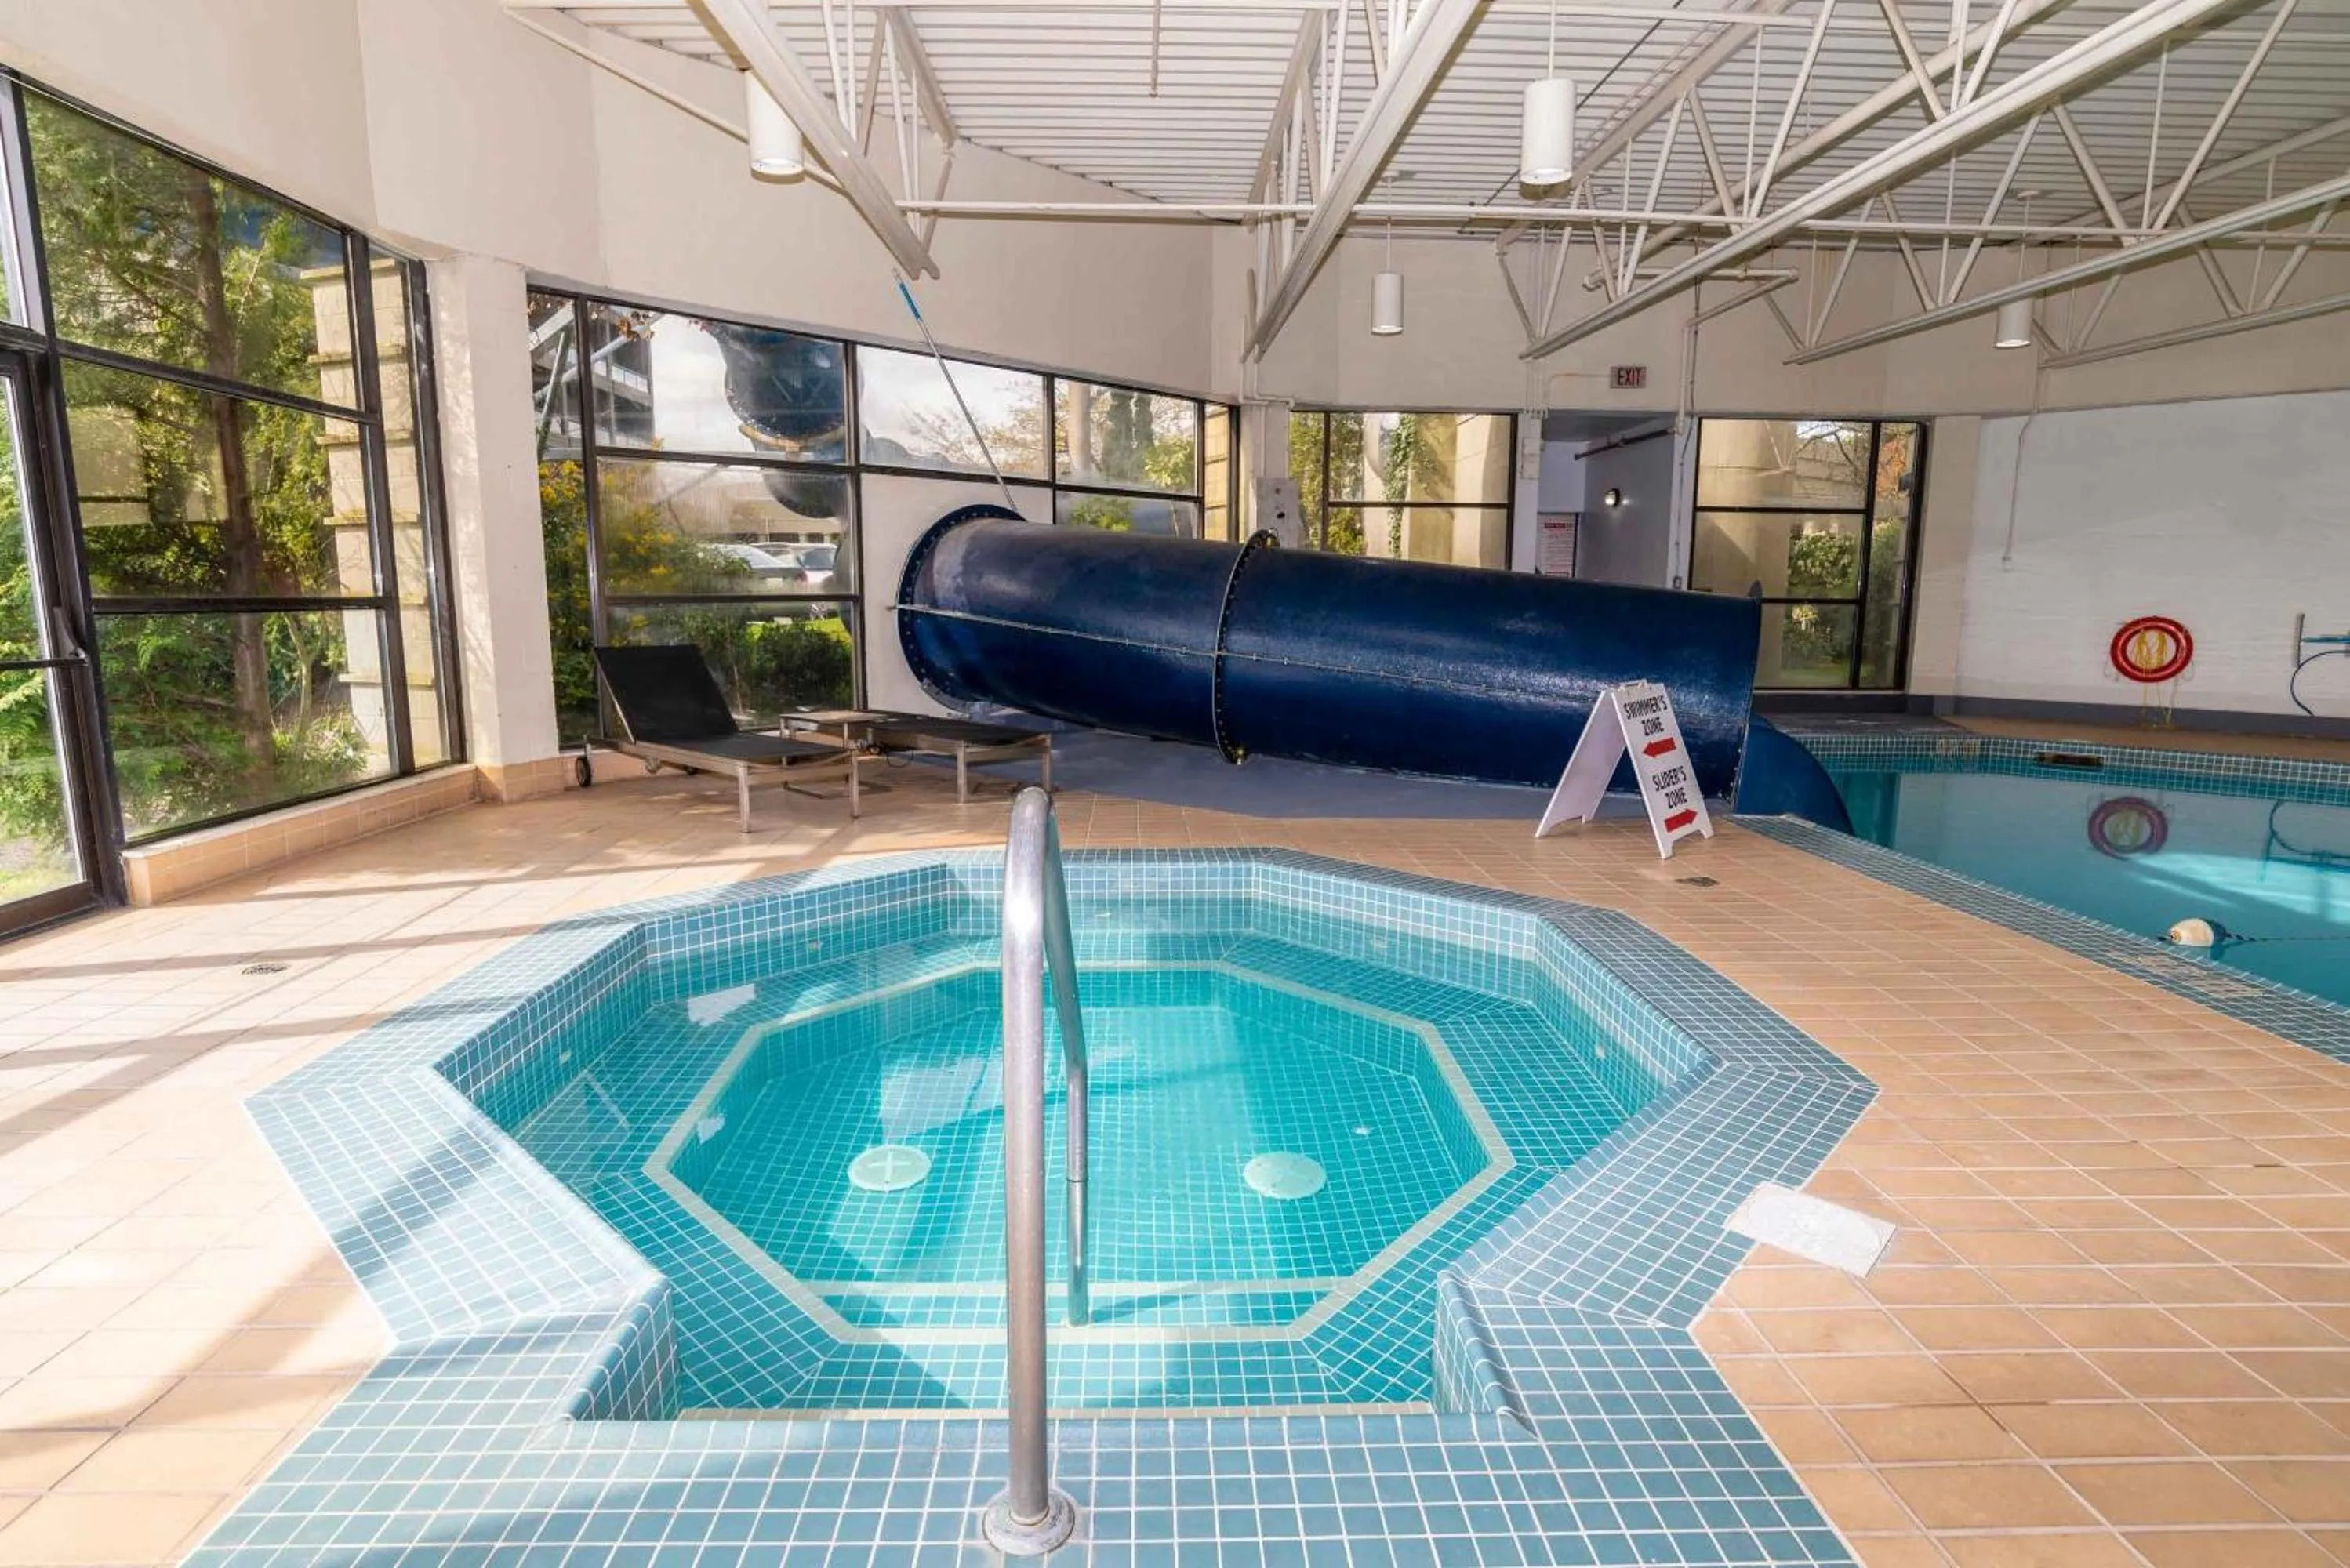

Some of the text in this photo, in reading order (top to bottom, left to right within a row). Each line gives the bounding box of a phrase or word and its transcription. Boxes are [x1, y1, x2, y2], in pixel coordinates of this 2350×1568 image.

[1618, 367, 1640, 387] EXIT
[1623, 695, 1667, 720] SWIMMER'S
[1641, 717, 1664, 736] ZONE
[1652, 765, 1687, 791] SLIDER'S
[1665, 787, 1687, 808] ZONE
